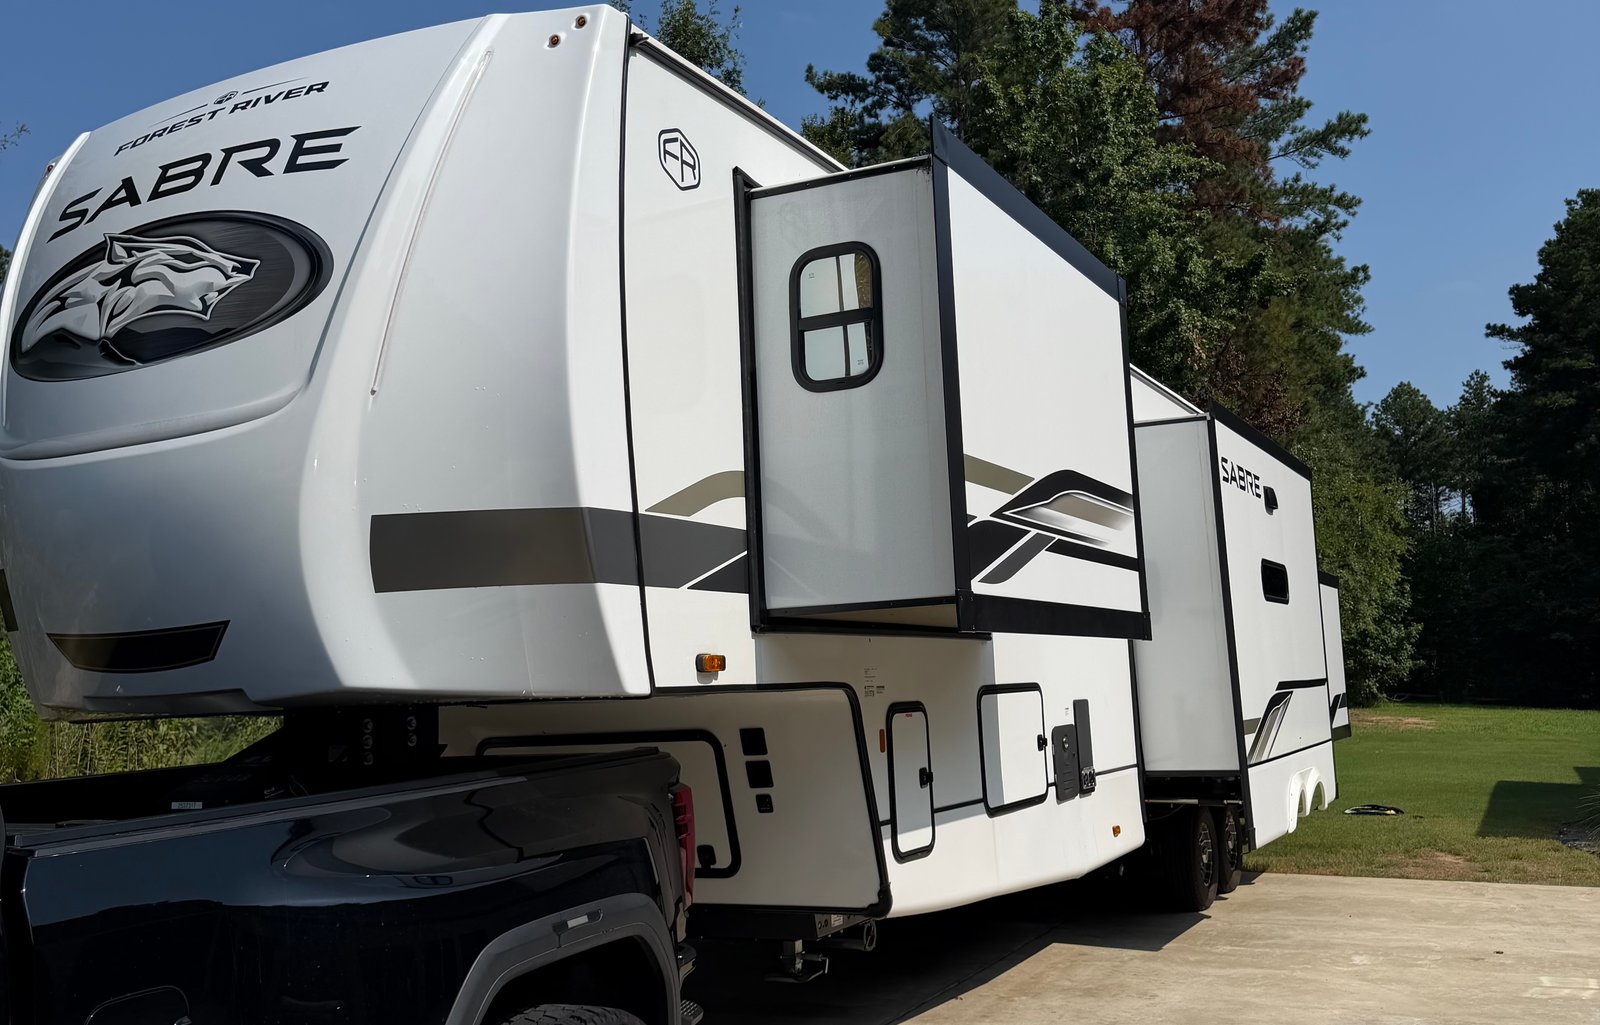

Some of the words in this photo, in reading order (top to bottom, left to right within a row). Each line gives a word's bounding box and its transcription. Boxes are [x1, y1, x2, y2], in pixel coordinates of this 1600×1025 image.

[114, 107, 226, 157] FOREST
[228, 81, 330, 115] RIVER
[46, 125, 362, 244] SABRE
[1221, 456, 1262, 499] SABRE
